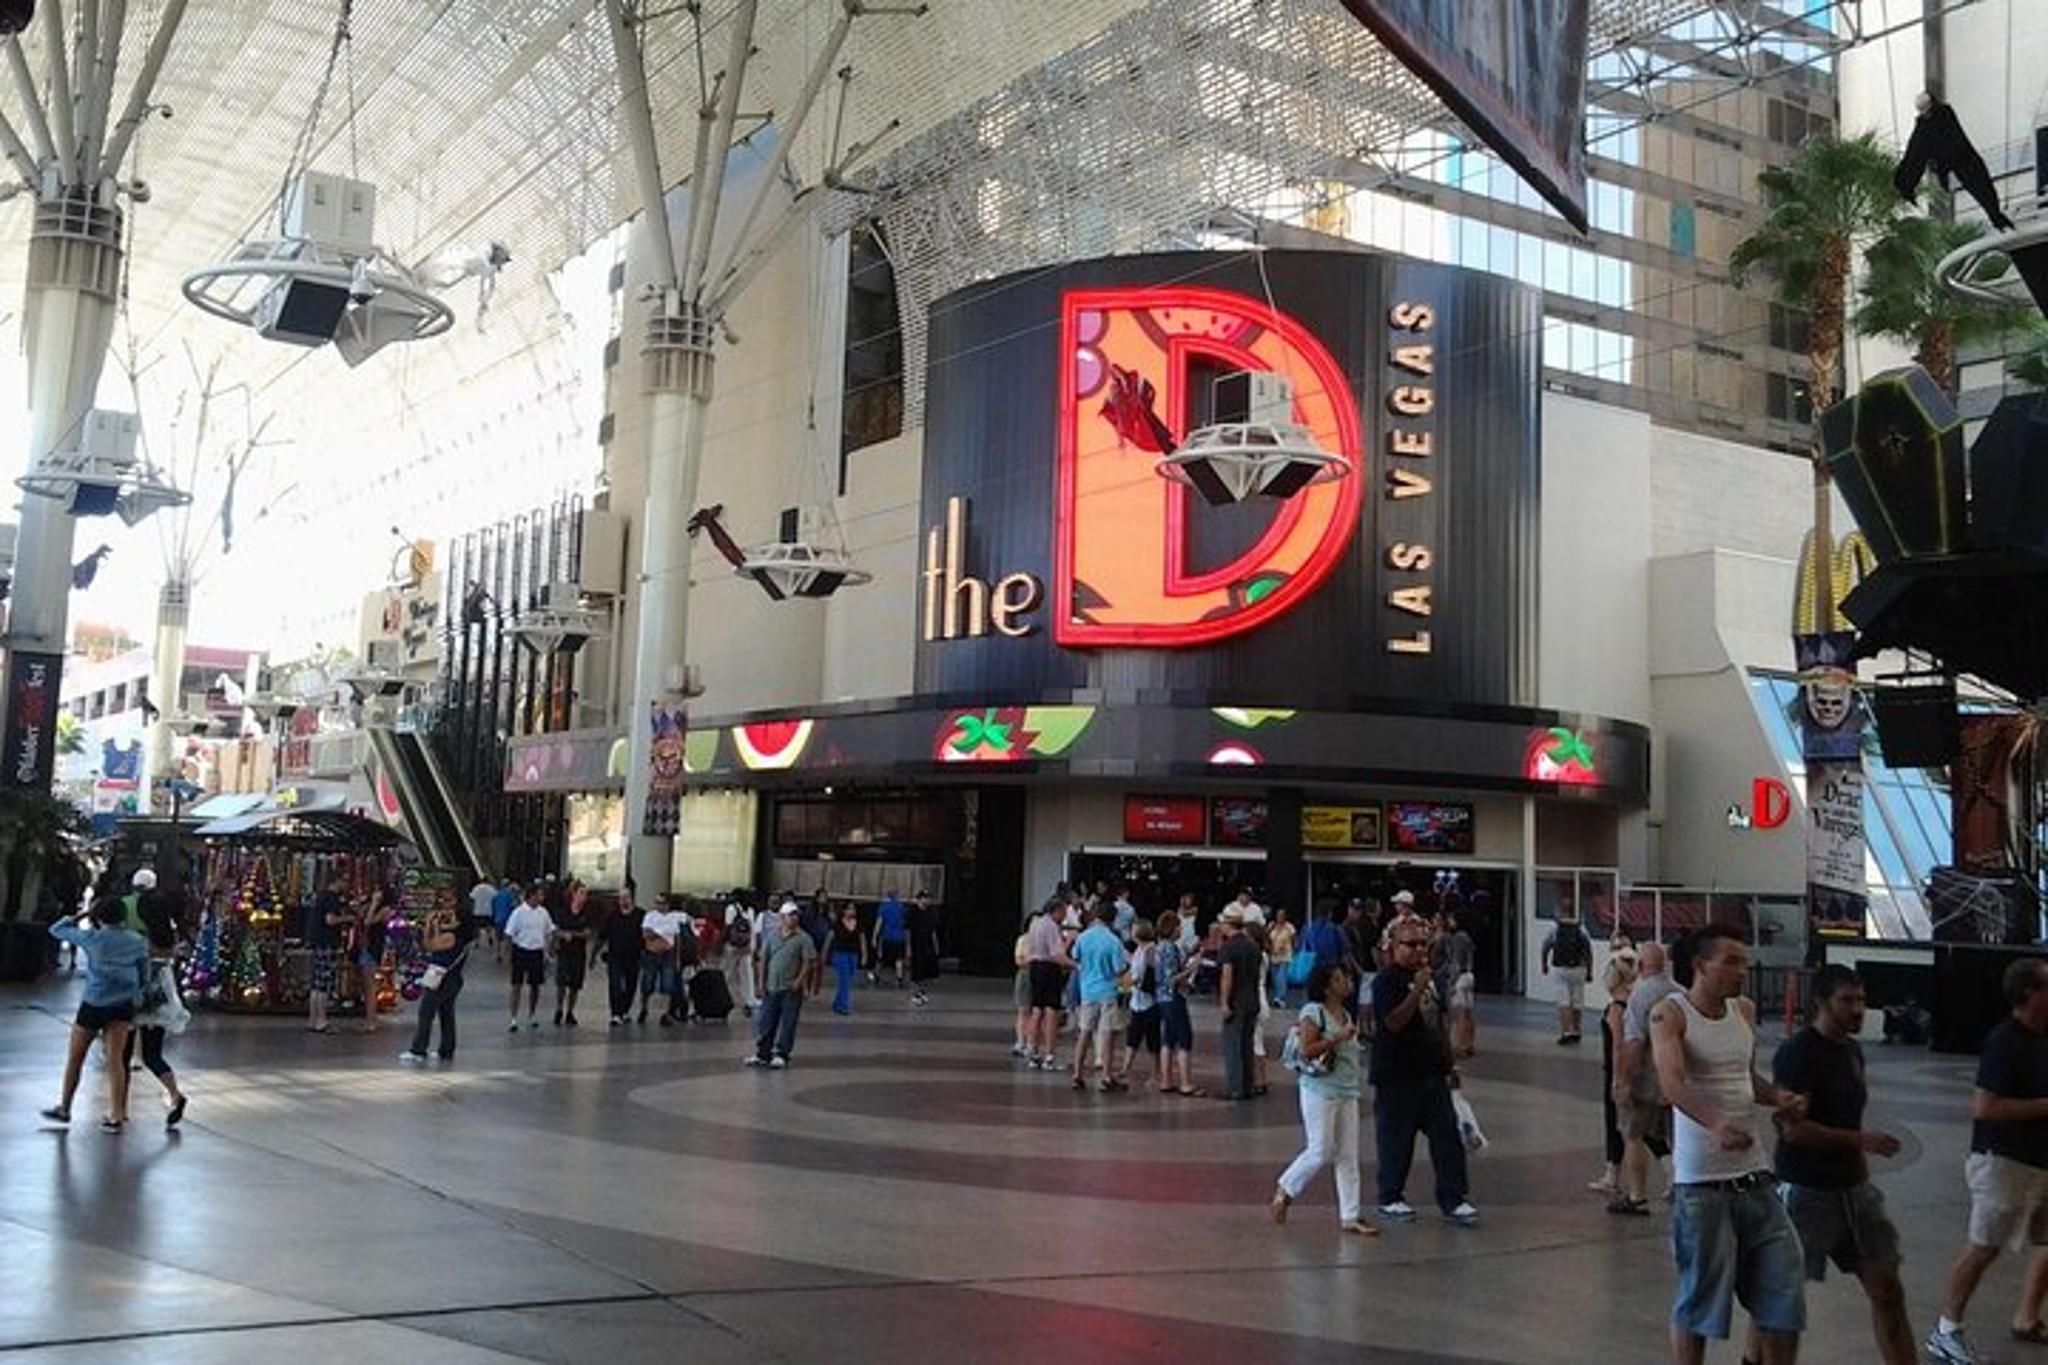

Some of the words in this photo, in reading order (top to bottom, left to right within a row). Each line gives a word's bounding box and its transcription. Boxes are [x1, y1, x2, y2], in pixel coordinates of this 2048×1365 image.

[922, 497, 1036, 641] the
[1056, 287, 1363, 645] D
[1386, 301, 1435, 500] VEGAS
[1386, 543, 1432, 653] LAS
[1752, 777, 1790, 830] D
